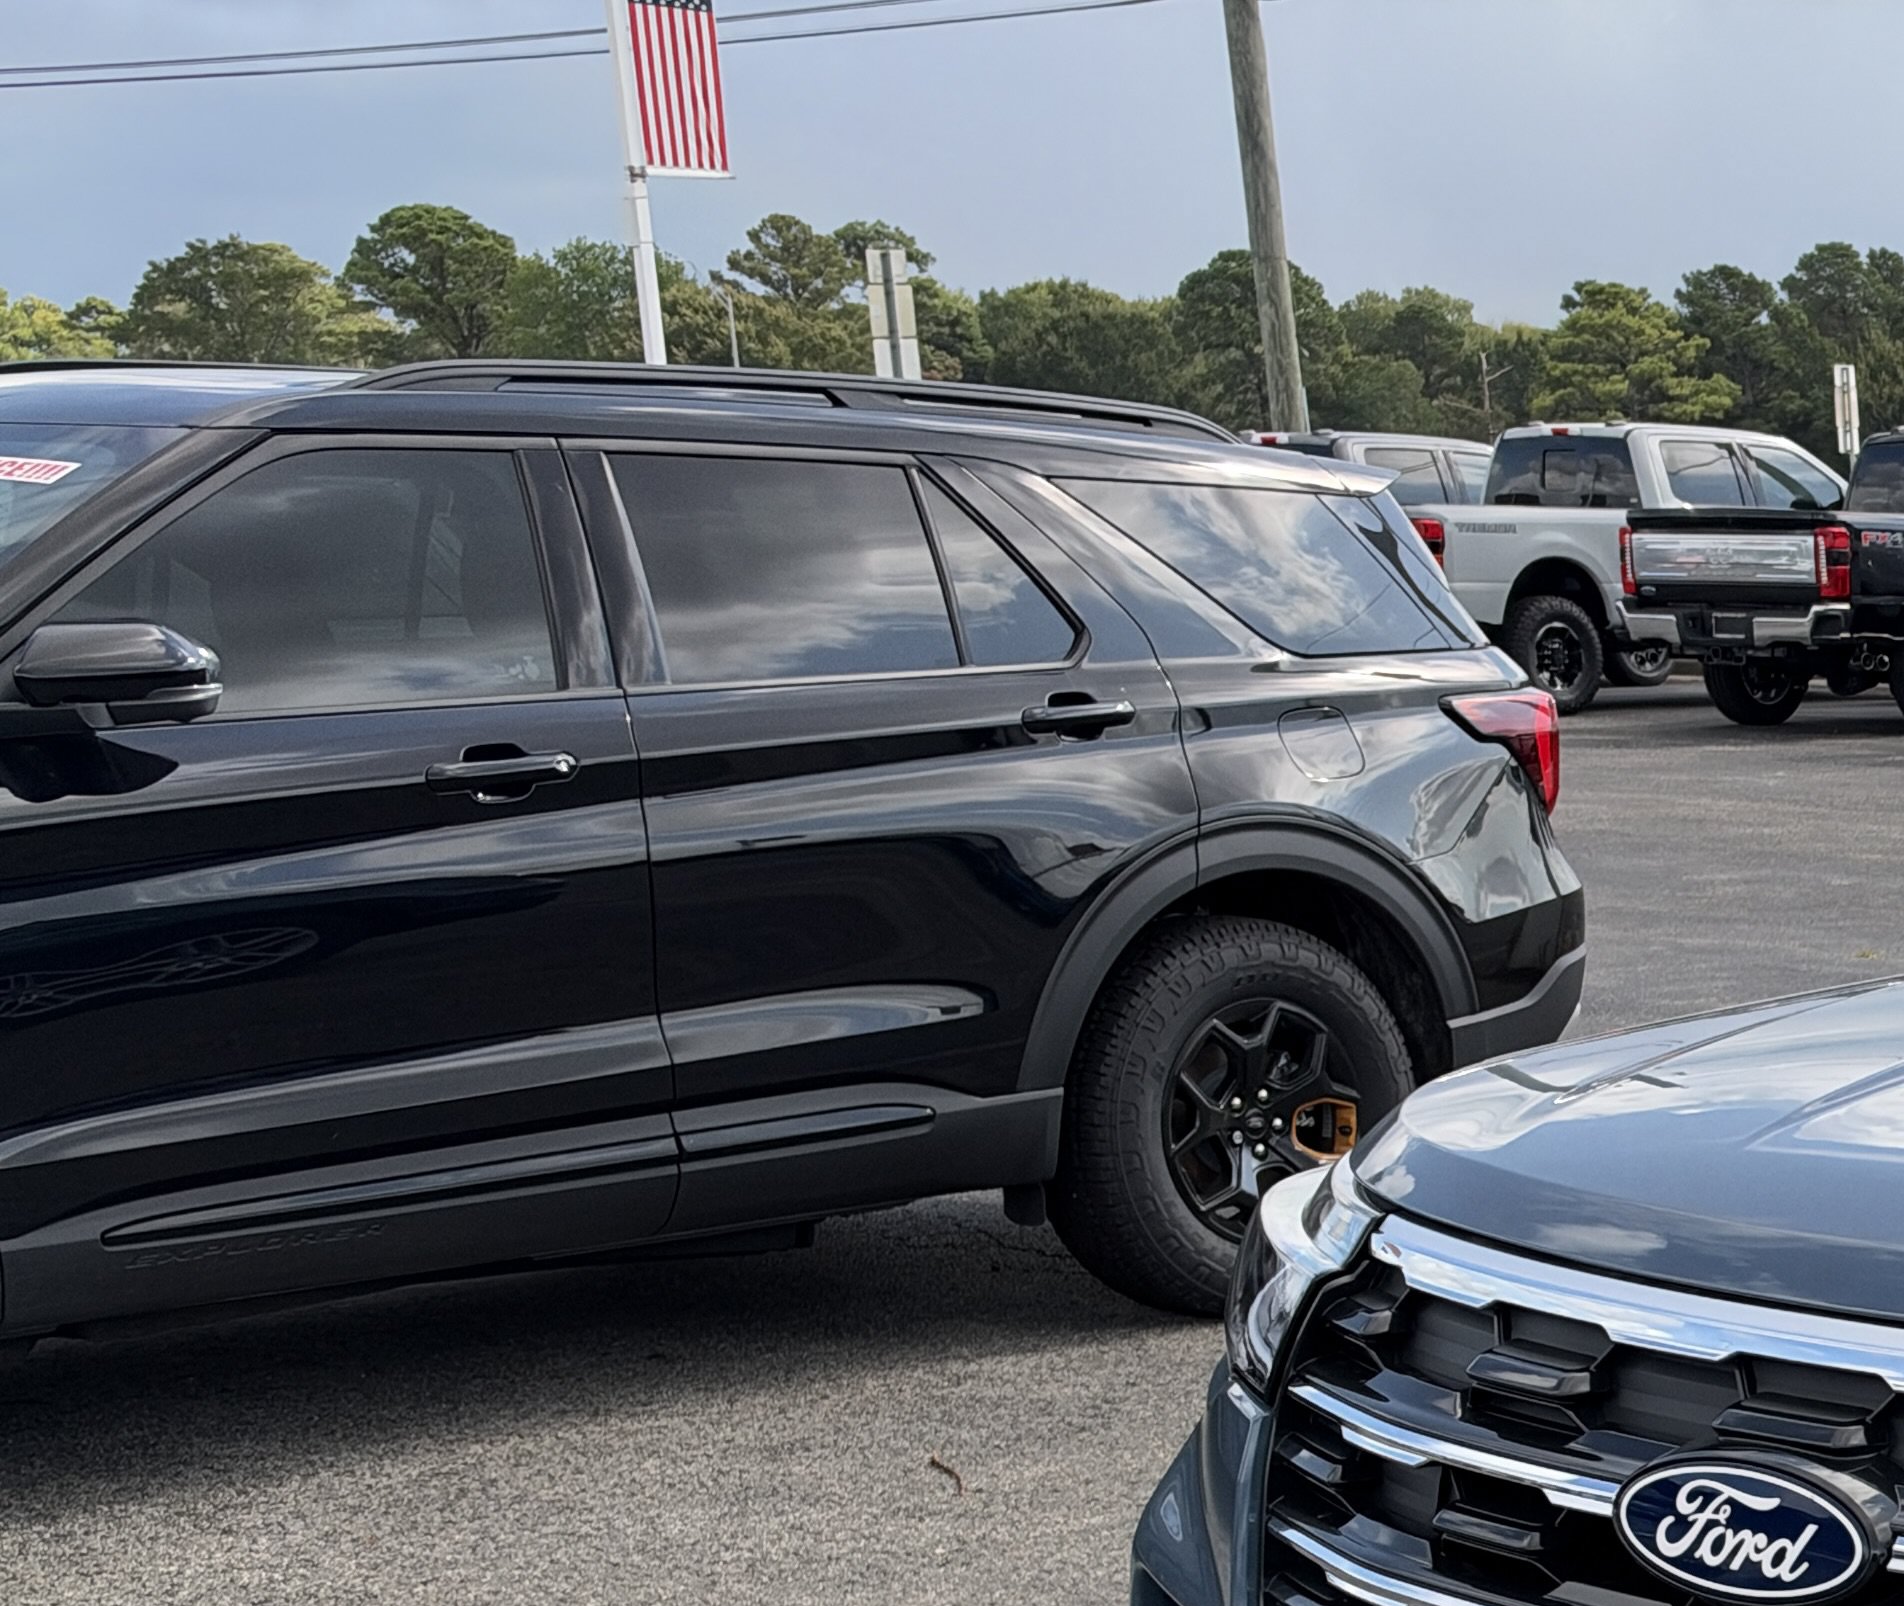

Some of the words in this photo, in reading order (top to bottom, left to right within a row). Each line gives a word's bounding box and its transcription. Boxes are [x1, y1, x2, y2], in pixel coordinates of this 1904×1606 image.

[1861, 531, 1904, 548] FX4
[123, 1223, 389, 1271] EXPLORER
[1655, 1478, 1819, 1582] Ford
